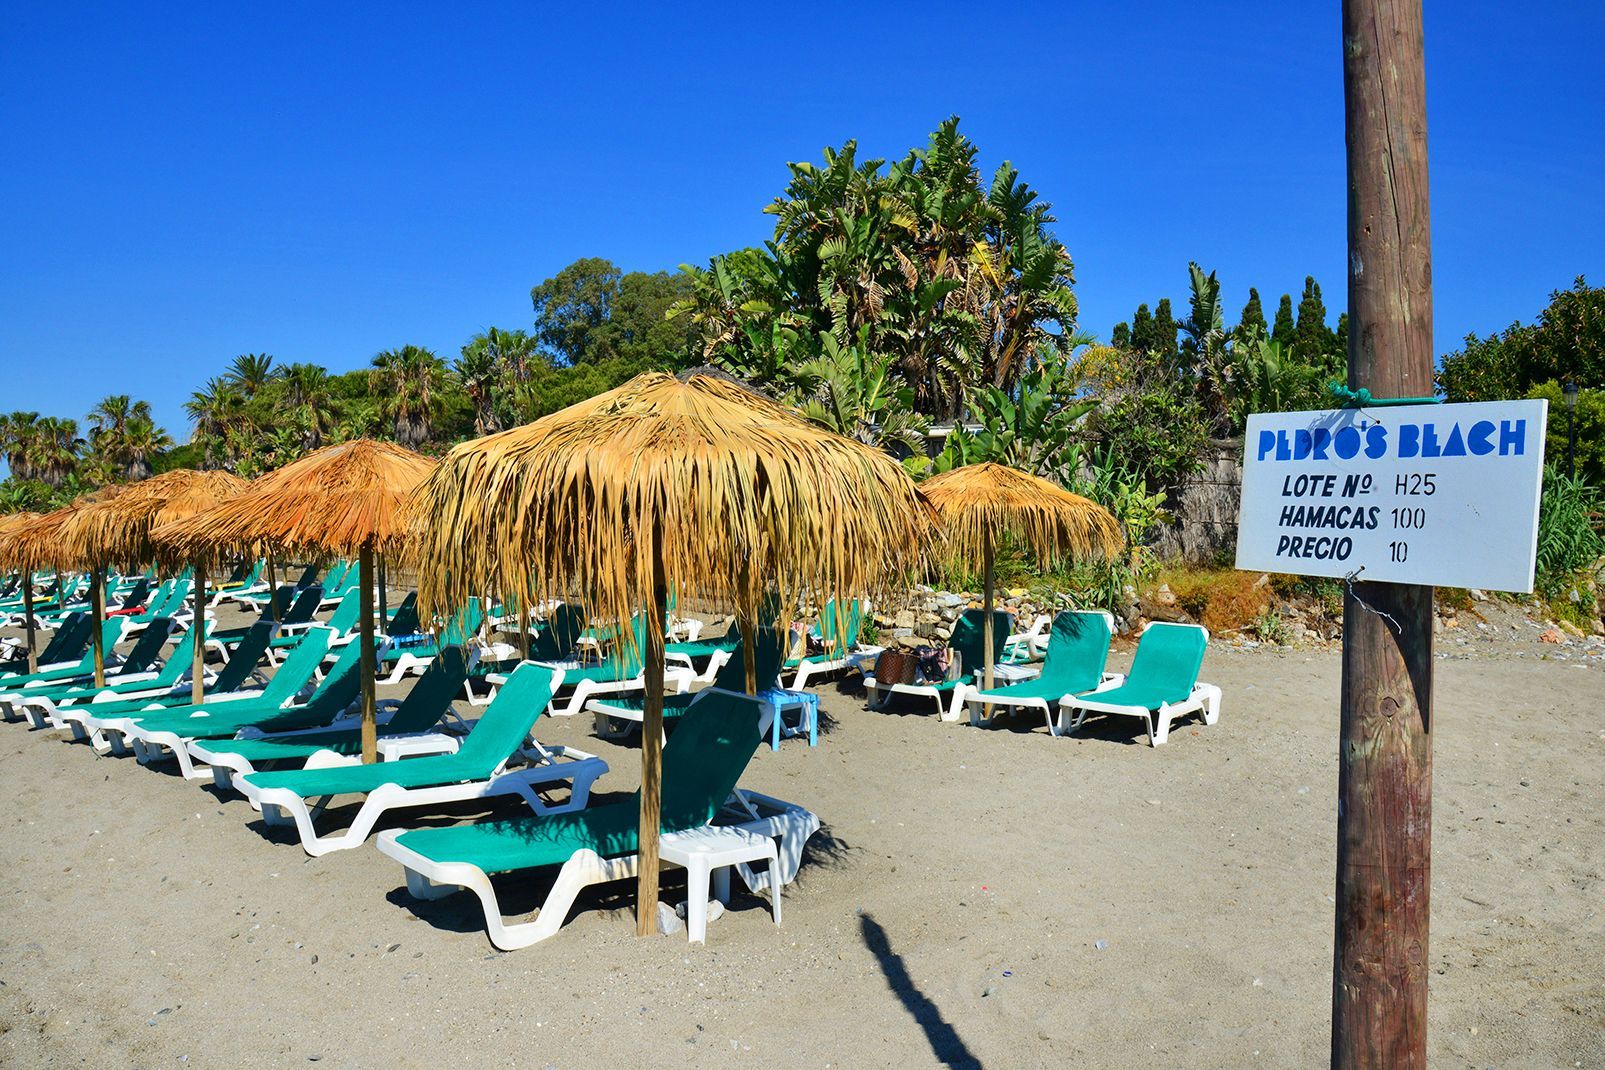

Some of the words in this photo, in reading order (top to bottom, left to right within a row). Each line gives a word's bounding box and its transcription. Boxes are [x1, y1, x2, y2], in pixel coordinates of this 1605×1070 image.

[1398, 419, 1526, 458] BEACH
[1281, 474, 1337, 497] LOTE
[1395, 473, 1437, 496] H25
[1278, 505, 1380, 530] HAMACAS
[1391, 508, 1426, 529] 100
[1275, 535, 1353, 560] PRECIO
[1389, 541, 1408, 563] 10
